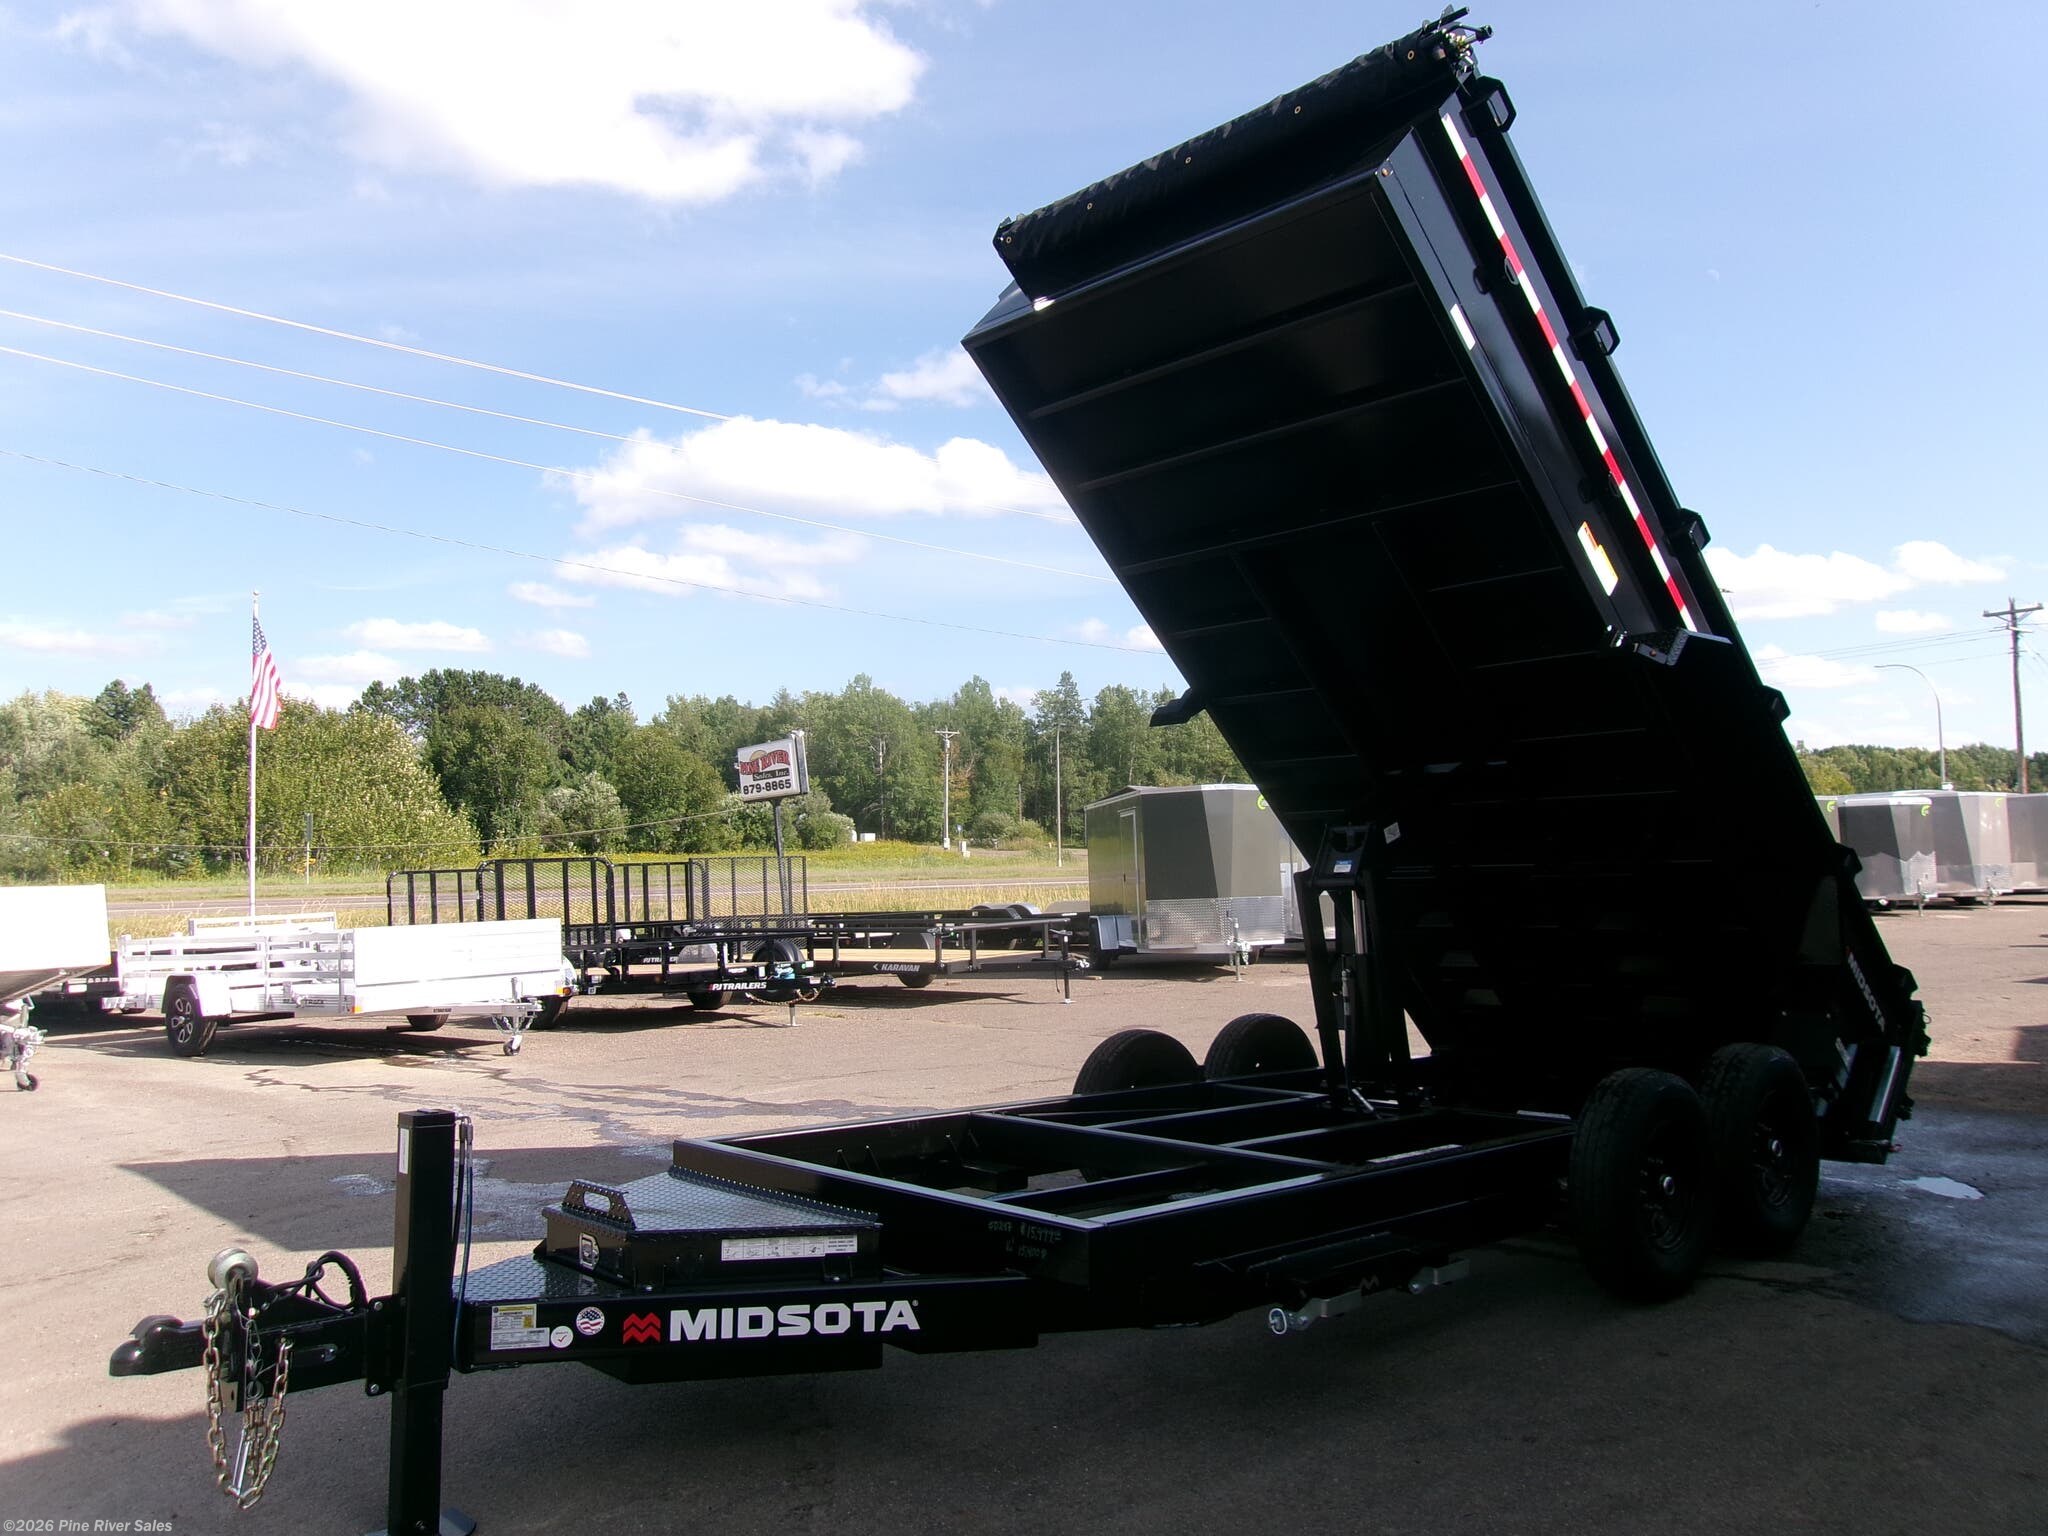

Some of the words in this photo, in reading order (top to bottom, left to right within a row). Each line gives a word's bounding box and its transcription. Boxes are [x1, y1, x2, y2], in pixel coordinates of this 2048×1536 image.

[761, 750, 791, 770] RIVER
[743, 779, 791, 795] 879-8865
[881, 964, 921, 972] KARAVAN
[1847, 952, 1886, 1033] MIDSOTA
[669, 1300, 921, 1342] MIDSOTA
